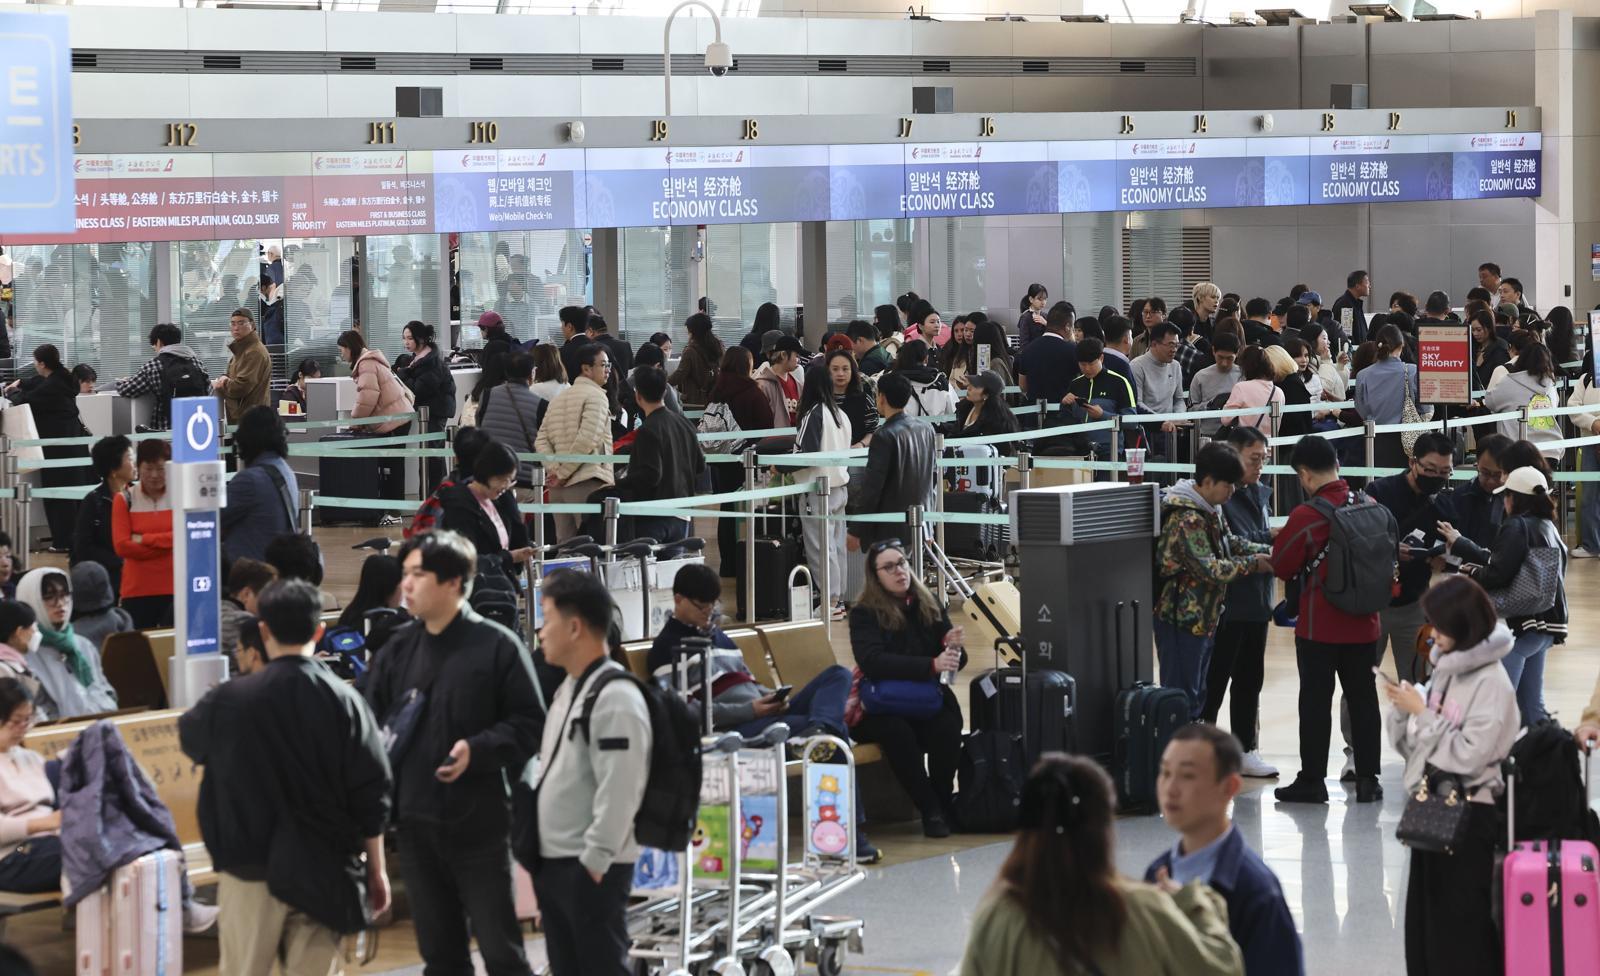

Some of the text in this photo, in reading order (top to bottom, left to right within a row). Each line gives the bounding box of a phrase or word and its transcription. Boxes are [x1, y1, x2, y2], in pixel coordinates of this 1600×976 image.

[743, 118, 759, 140] J8
[899, 117, 913, 138] J7
[980, 116, 996, 137] J6
[1121, 114, 1136, 134] J5
[1193, 113, 1208, 133] J4
[1322, 112, 1336, 131] J3
[1388, 111, 1401, 130] J2
[1505, 110, 1517, 128] J1
[165, 122, 199, 147] J12
[367, 120, 397, 145] J11
[469, 120, 498, 144] J10
[652, 119, 669, 141] J9
[1129, 165, 1194, 186] 일반석 经济舱
[1330, 160, 1388, 180] 일반석 经济舱
[1490, 158, 1511, 174] 일반석
[487, 176, 552, 194] 웹/모바일 체크인
[662, 175, 742, 198] 일반석 经济舱
[909, 169, 981, 191] 일반석 经济舱
[1322, 180, 1400, 198] ECONOMY CLASS
[1479, 176, 1536, 192] ECONOMY CLASS
[900, 191, 995, 212] ECONOMY CLASS
[1121, 185, 1207, 205] ECONOMY CLASS
[292, 212, 307, 221] SKY
[489, 211, 525, 222] Web/Mobile
[653, 198, 759, 219] ECONOMY CLASS
[74, 217, 99, 229] INESS
[99, 216, 125, 228] CLASS
[132, 216, 167, 228] EASTERN
[168, 215, 191, 227] MILES
[191, 214, 231, 227] PLATINUM,
[232, 213, 254, 226] GOLD,
[255, 213, 280, 225] SILVER
[292, 220, 327, 230] PRIORITY
[1421, 360, 1464, 368] PRIORITY
